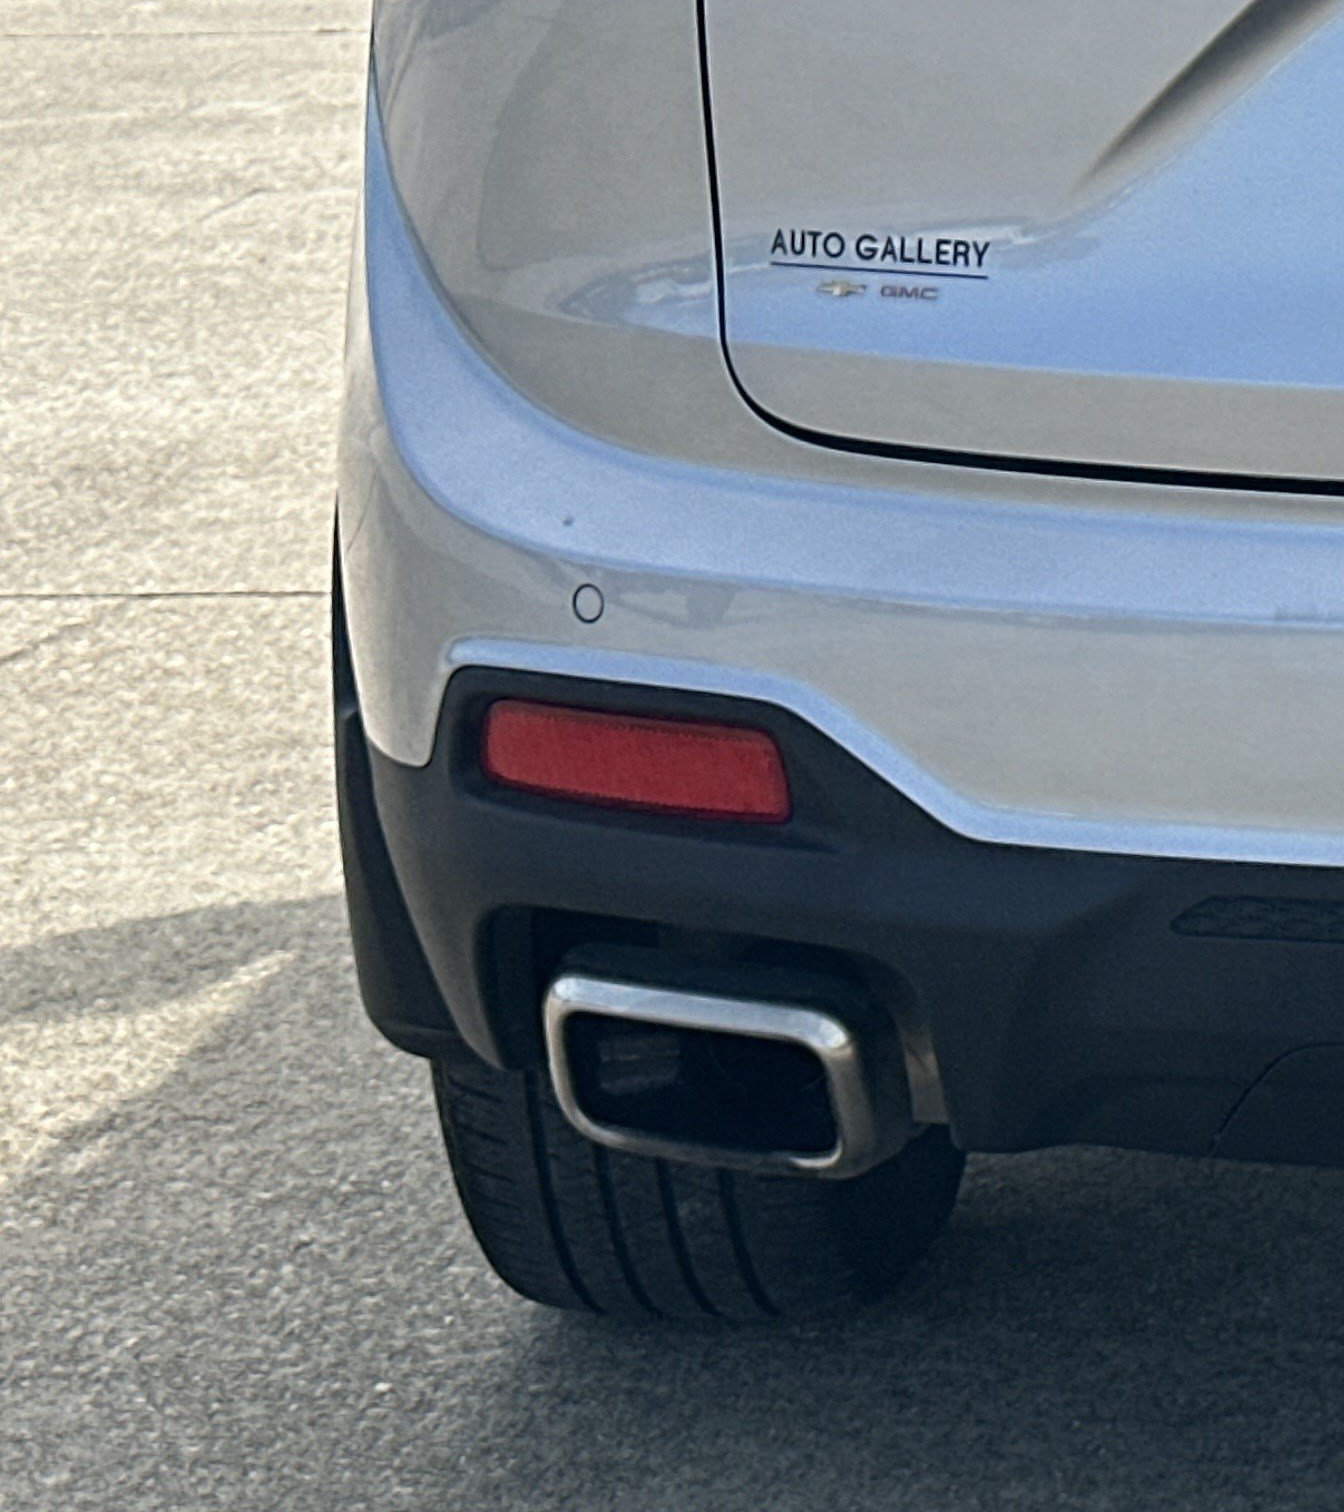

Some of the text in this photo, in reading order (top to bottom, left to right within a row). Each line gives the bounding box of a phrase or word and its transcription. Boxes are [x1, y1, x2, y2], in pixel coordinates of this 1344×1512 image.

[770, 227, 991, 269] AUTO GALLERY
[879, 284, 940, 301] GMC
